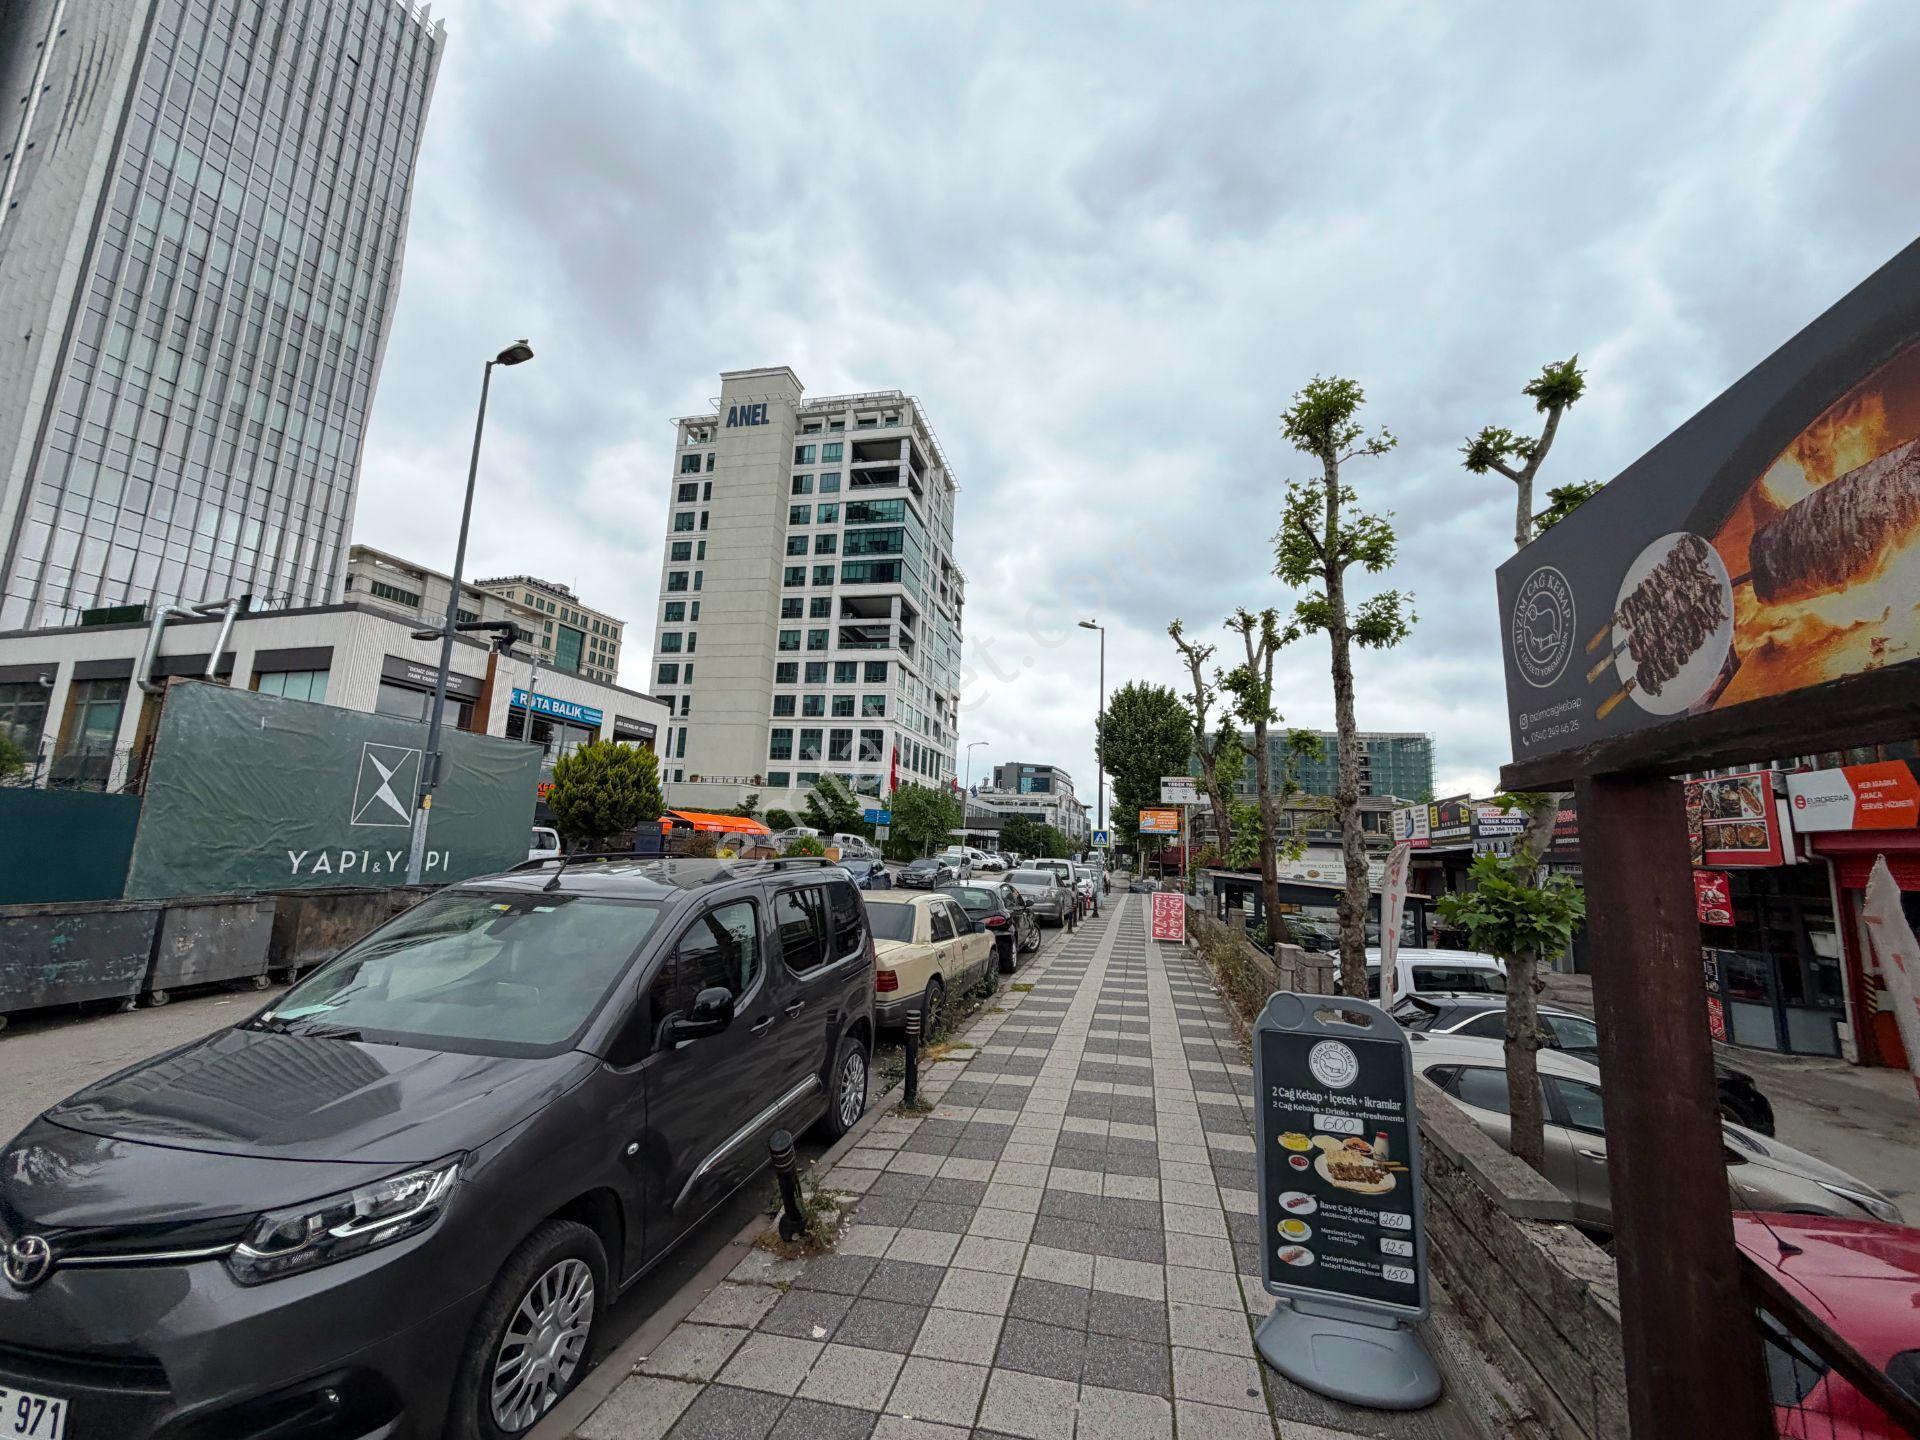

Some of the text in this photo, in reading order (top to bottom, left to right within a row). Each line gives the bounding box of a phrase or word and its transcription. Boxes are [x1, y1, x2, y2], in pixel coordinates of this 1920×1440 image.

[726, 403, 770, 428] ANEL
[1547, 575, 1571, 619] KEBAP
[552, 701, 582, 718] BALIK
[1569, 719, 1580, 732] 25
[1806, 794, 1849, 805] EUROREPAR
[288, 850, 370, 875] YAPI
[386, 850, 450, 873] YPI
[1272, 1087, 1278, 1097] 2
[1295, 1090, 1322, 1104] Kebap
[1329, 1090, 1358, 1106] İçecek
[1293, 1104, 1320, 1113] Kebabs
[1325, 1107, 1350, 1117] Drinks
[1355, 1111, 1405, 1123] refreshments
[1323, 1116, 1355, 1132] 600
[1353, 1207, 1378, 1219] Kebap
[1381, 1213, 1404, 1227] 260
[1344, 1239, 1359, 1247] Soup
[1384, 1241, 1404, 1255] 125
[1386, 1267, 1409, 1281] 150
[15, 1395, 61, 1439] 971
